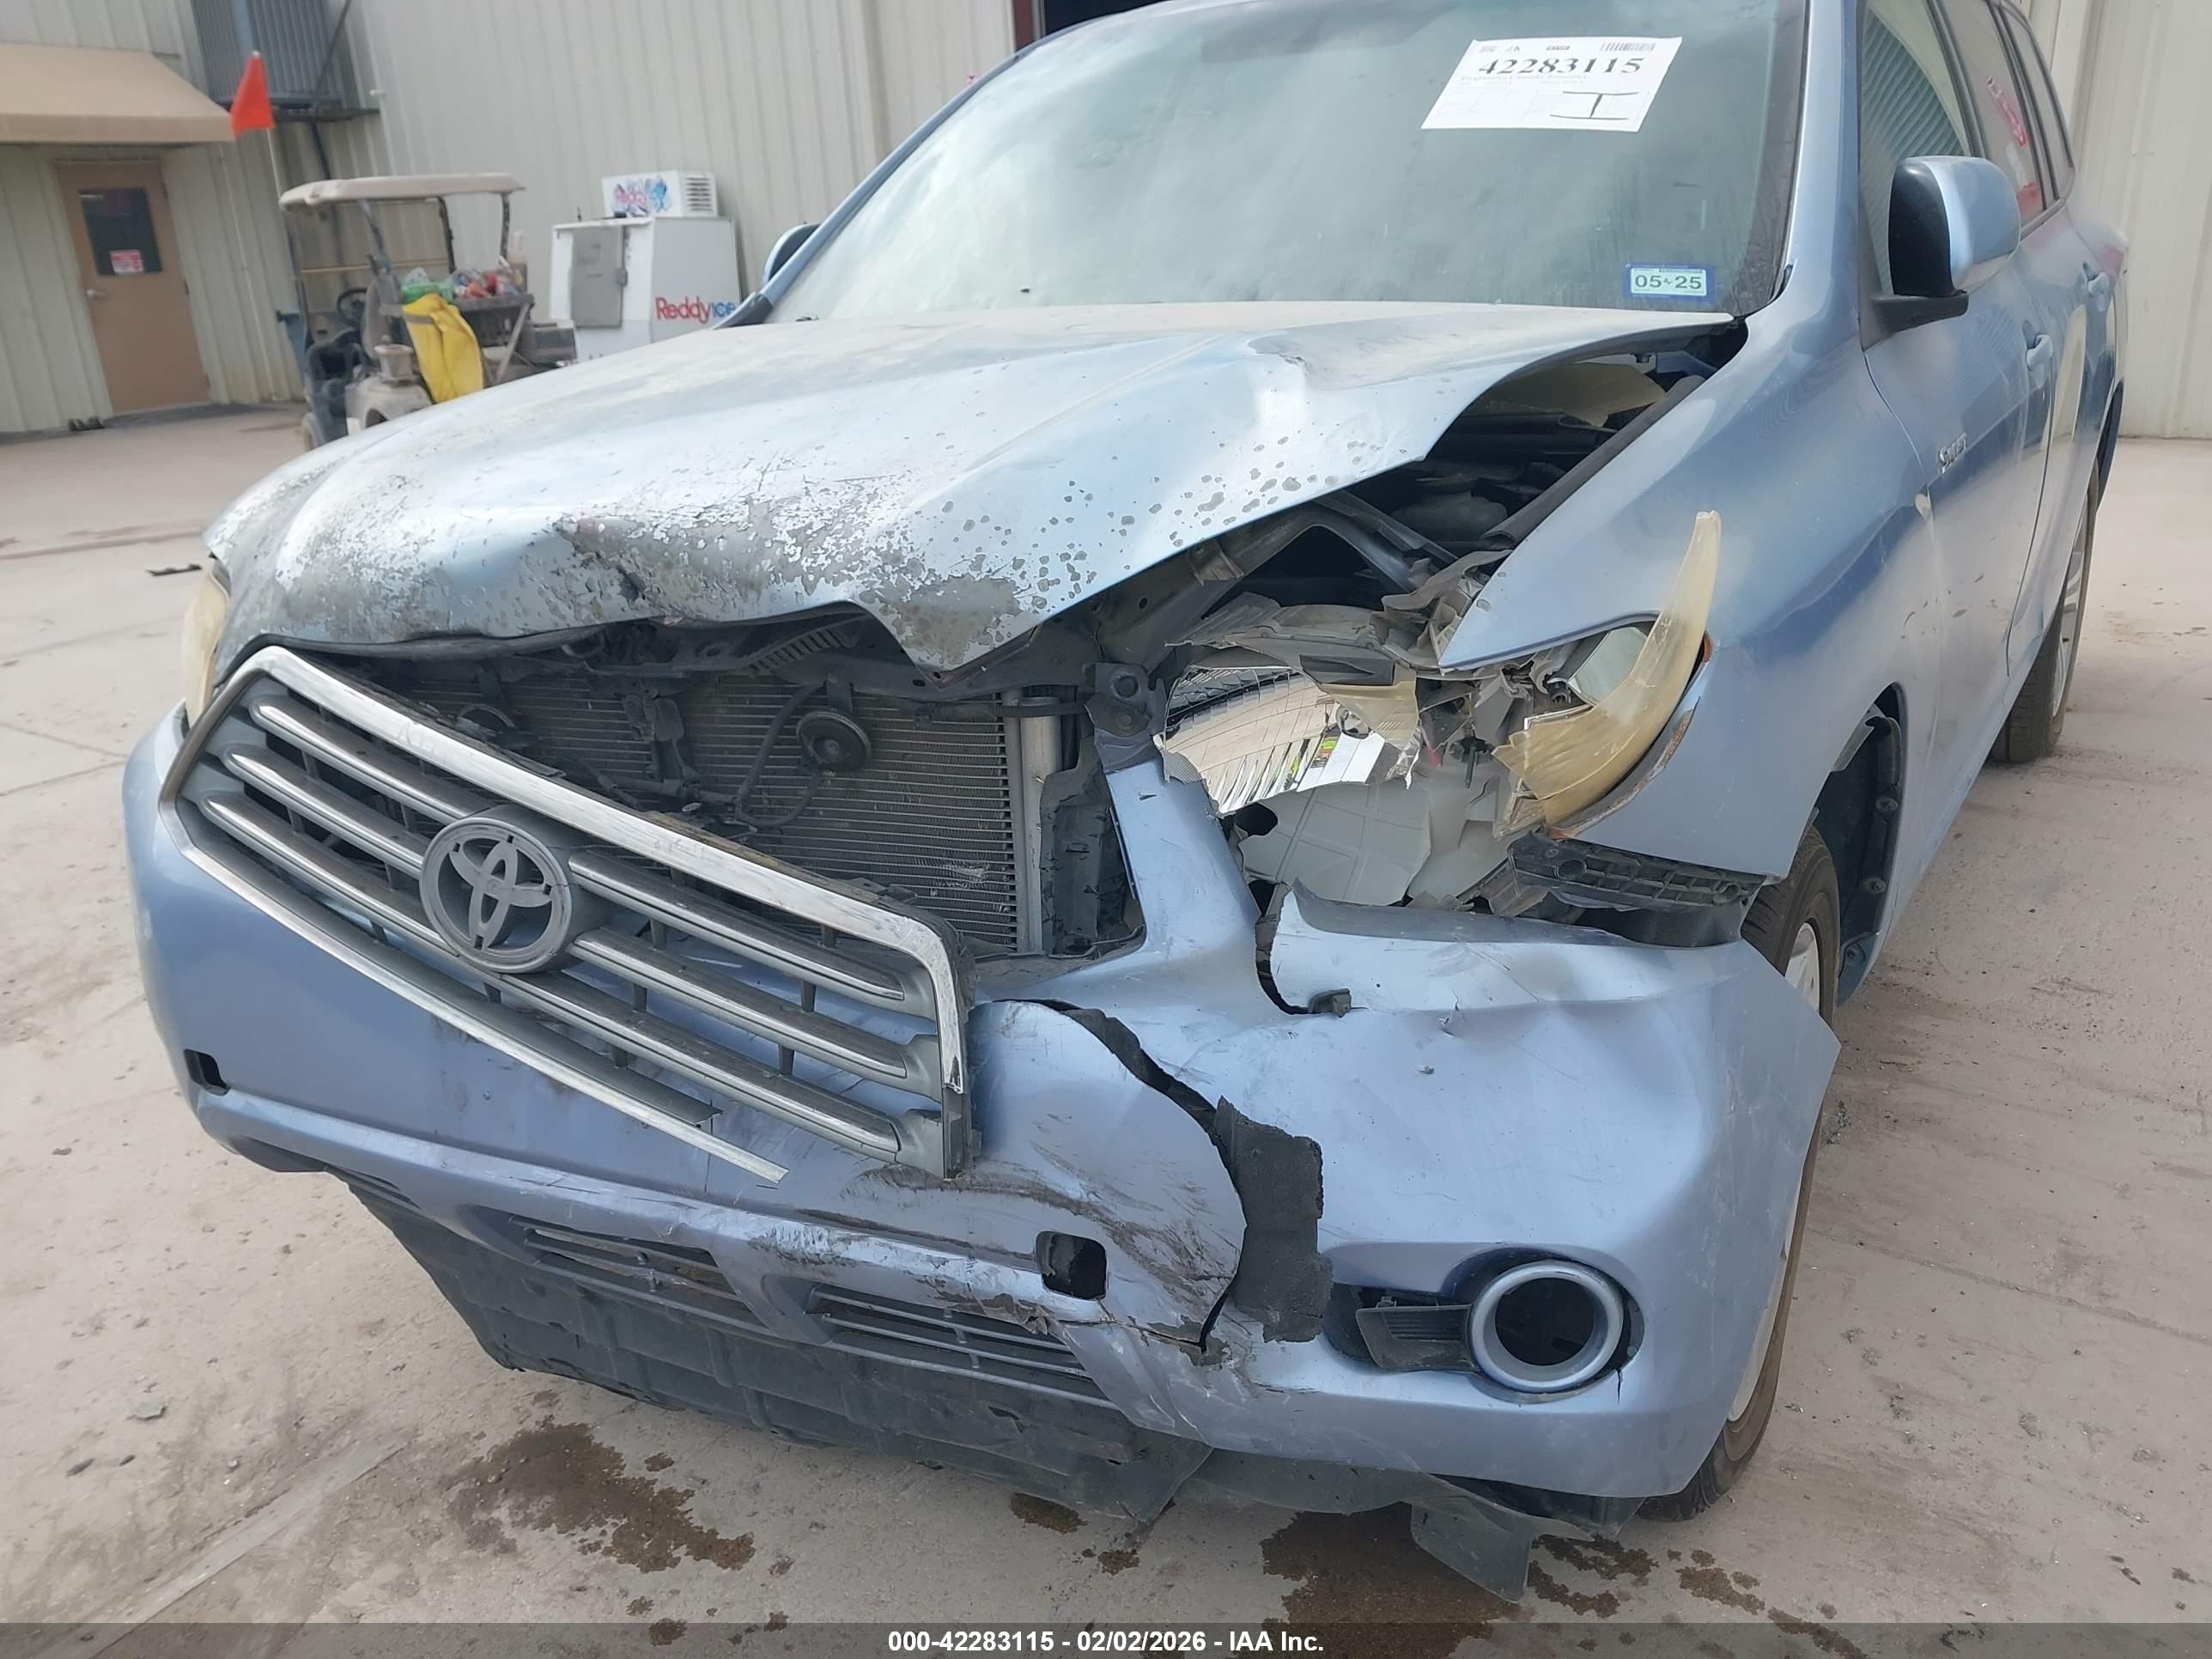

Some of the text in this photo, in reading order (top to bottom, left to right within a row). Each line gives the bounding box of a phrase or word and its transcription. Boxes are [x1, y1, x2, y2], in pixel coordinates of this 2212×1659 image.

[1478, 57, 1645, 75] 42283115
[1634, 275, 1702, 289] 05 25
